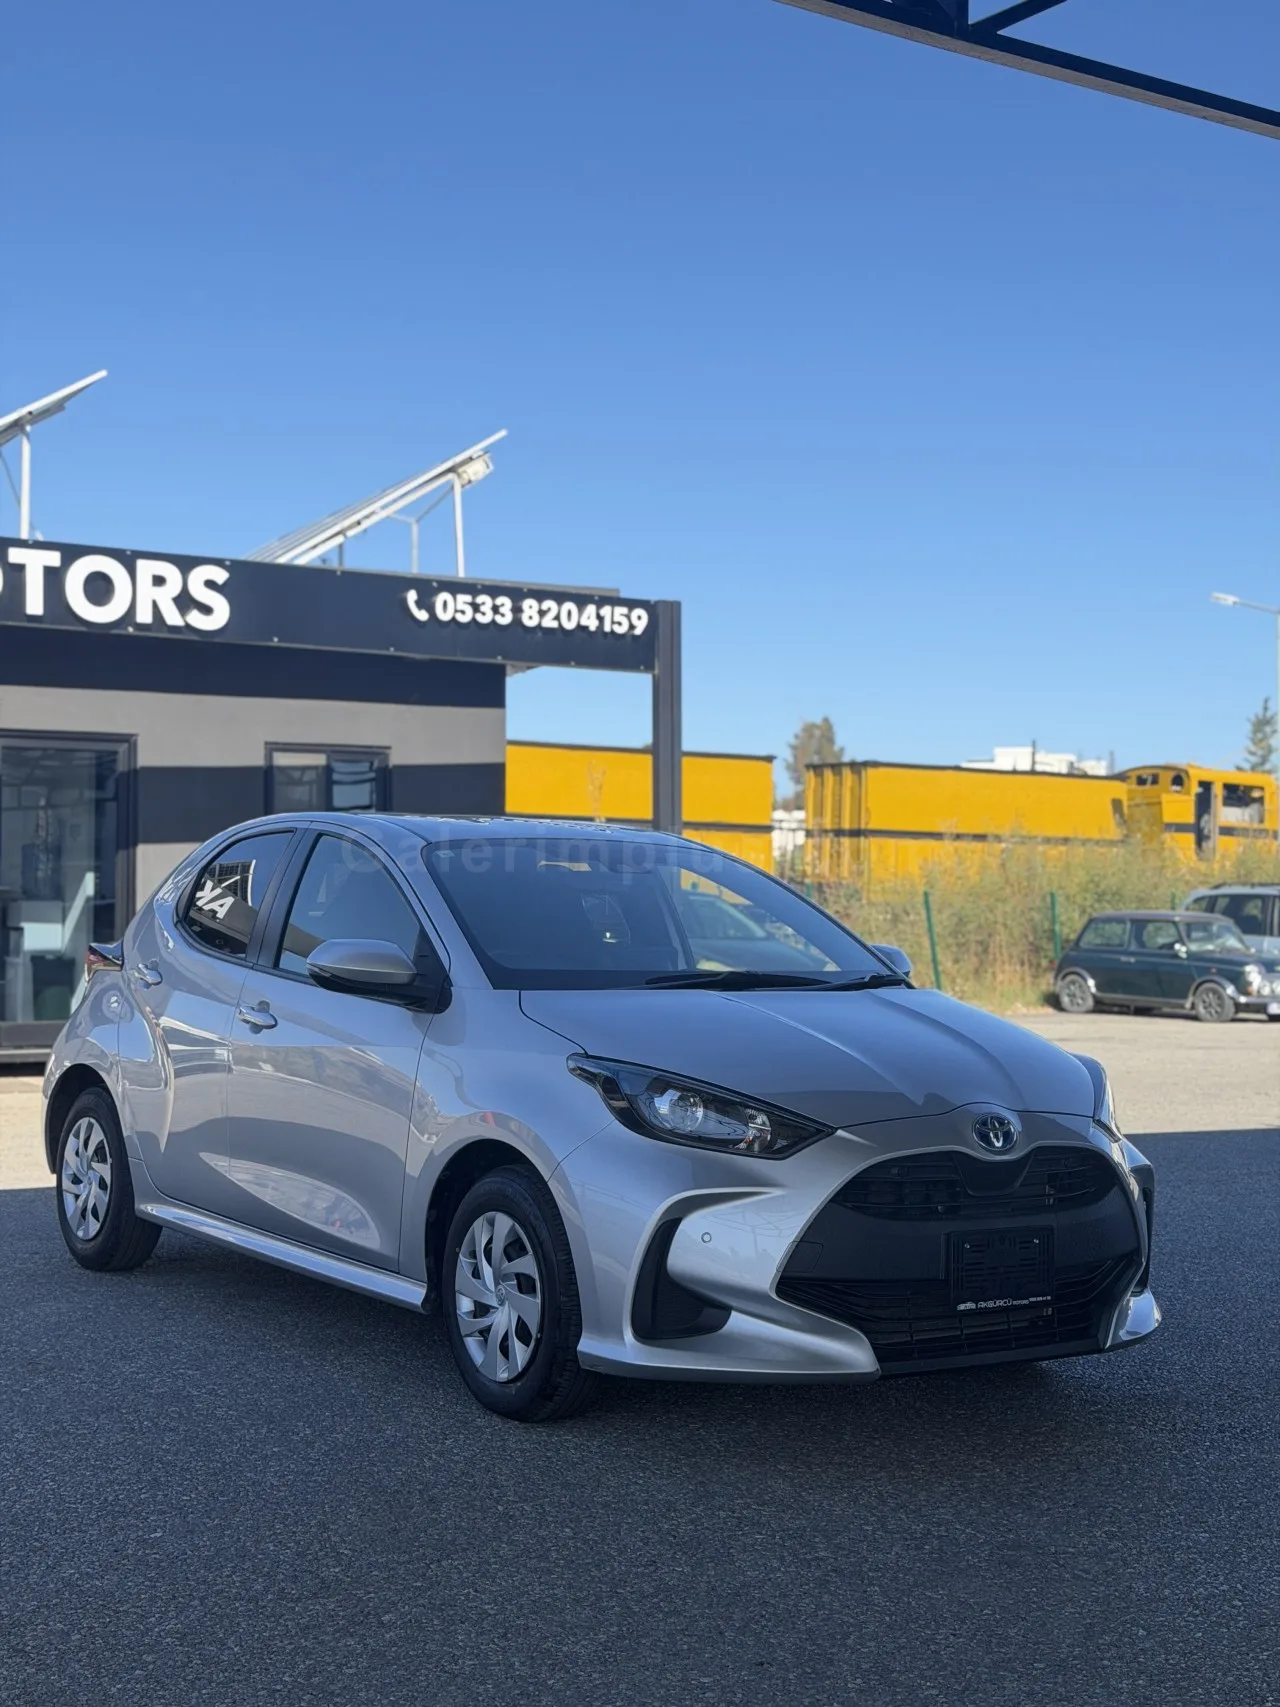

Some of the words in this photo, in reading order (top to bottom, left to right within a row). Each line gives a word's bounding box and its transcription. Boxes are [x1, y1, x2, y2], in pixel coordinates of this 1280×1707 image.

[0, 547, 231, 631] TORS
[434, 591, 513, 625] 0533
[521, 598, 648, 635] 8204159
